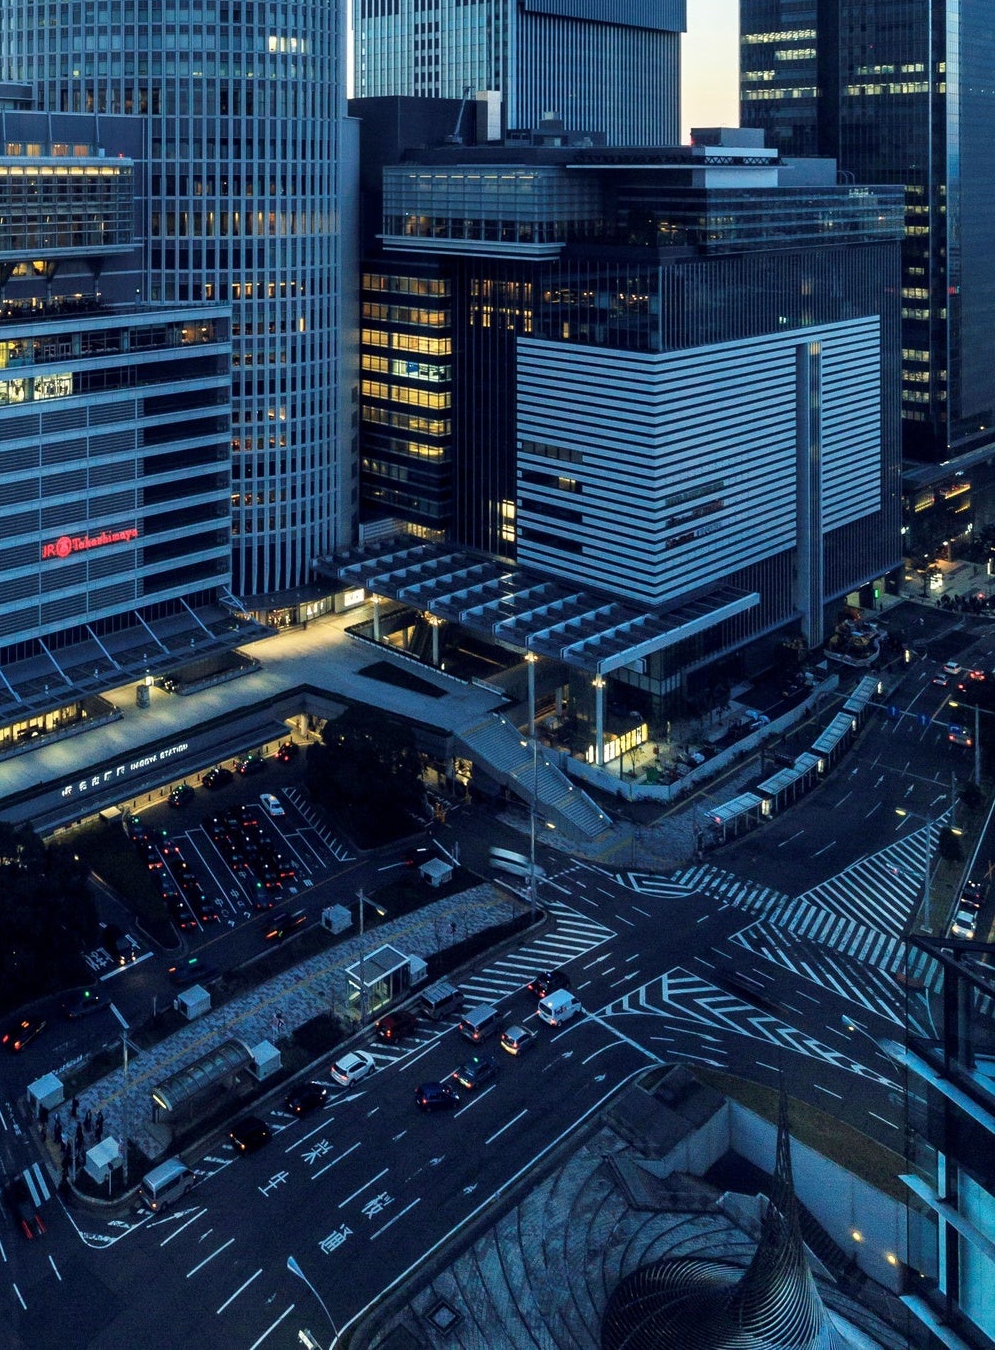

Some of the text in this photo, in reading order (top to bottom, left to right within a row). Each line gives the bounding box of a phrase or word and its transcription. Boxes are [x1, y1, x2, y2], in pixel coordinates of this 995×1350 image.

[42, 543, 56, 558] JR
[72, 528, 138, 551] Takashimaya
[318, 1191, 394, 1254] 桜通
